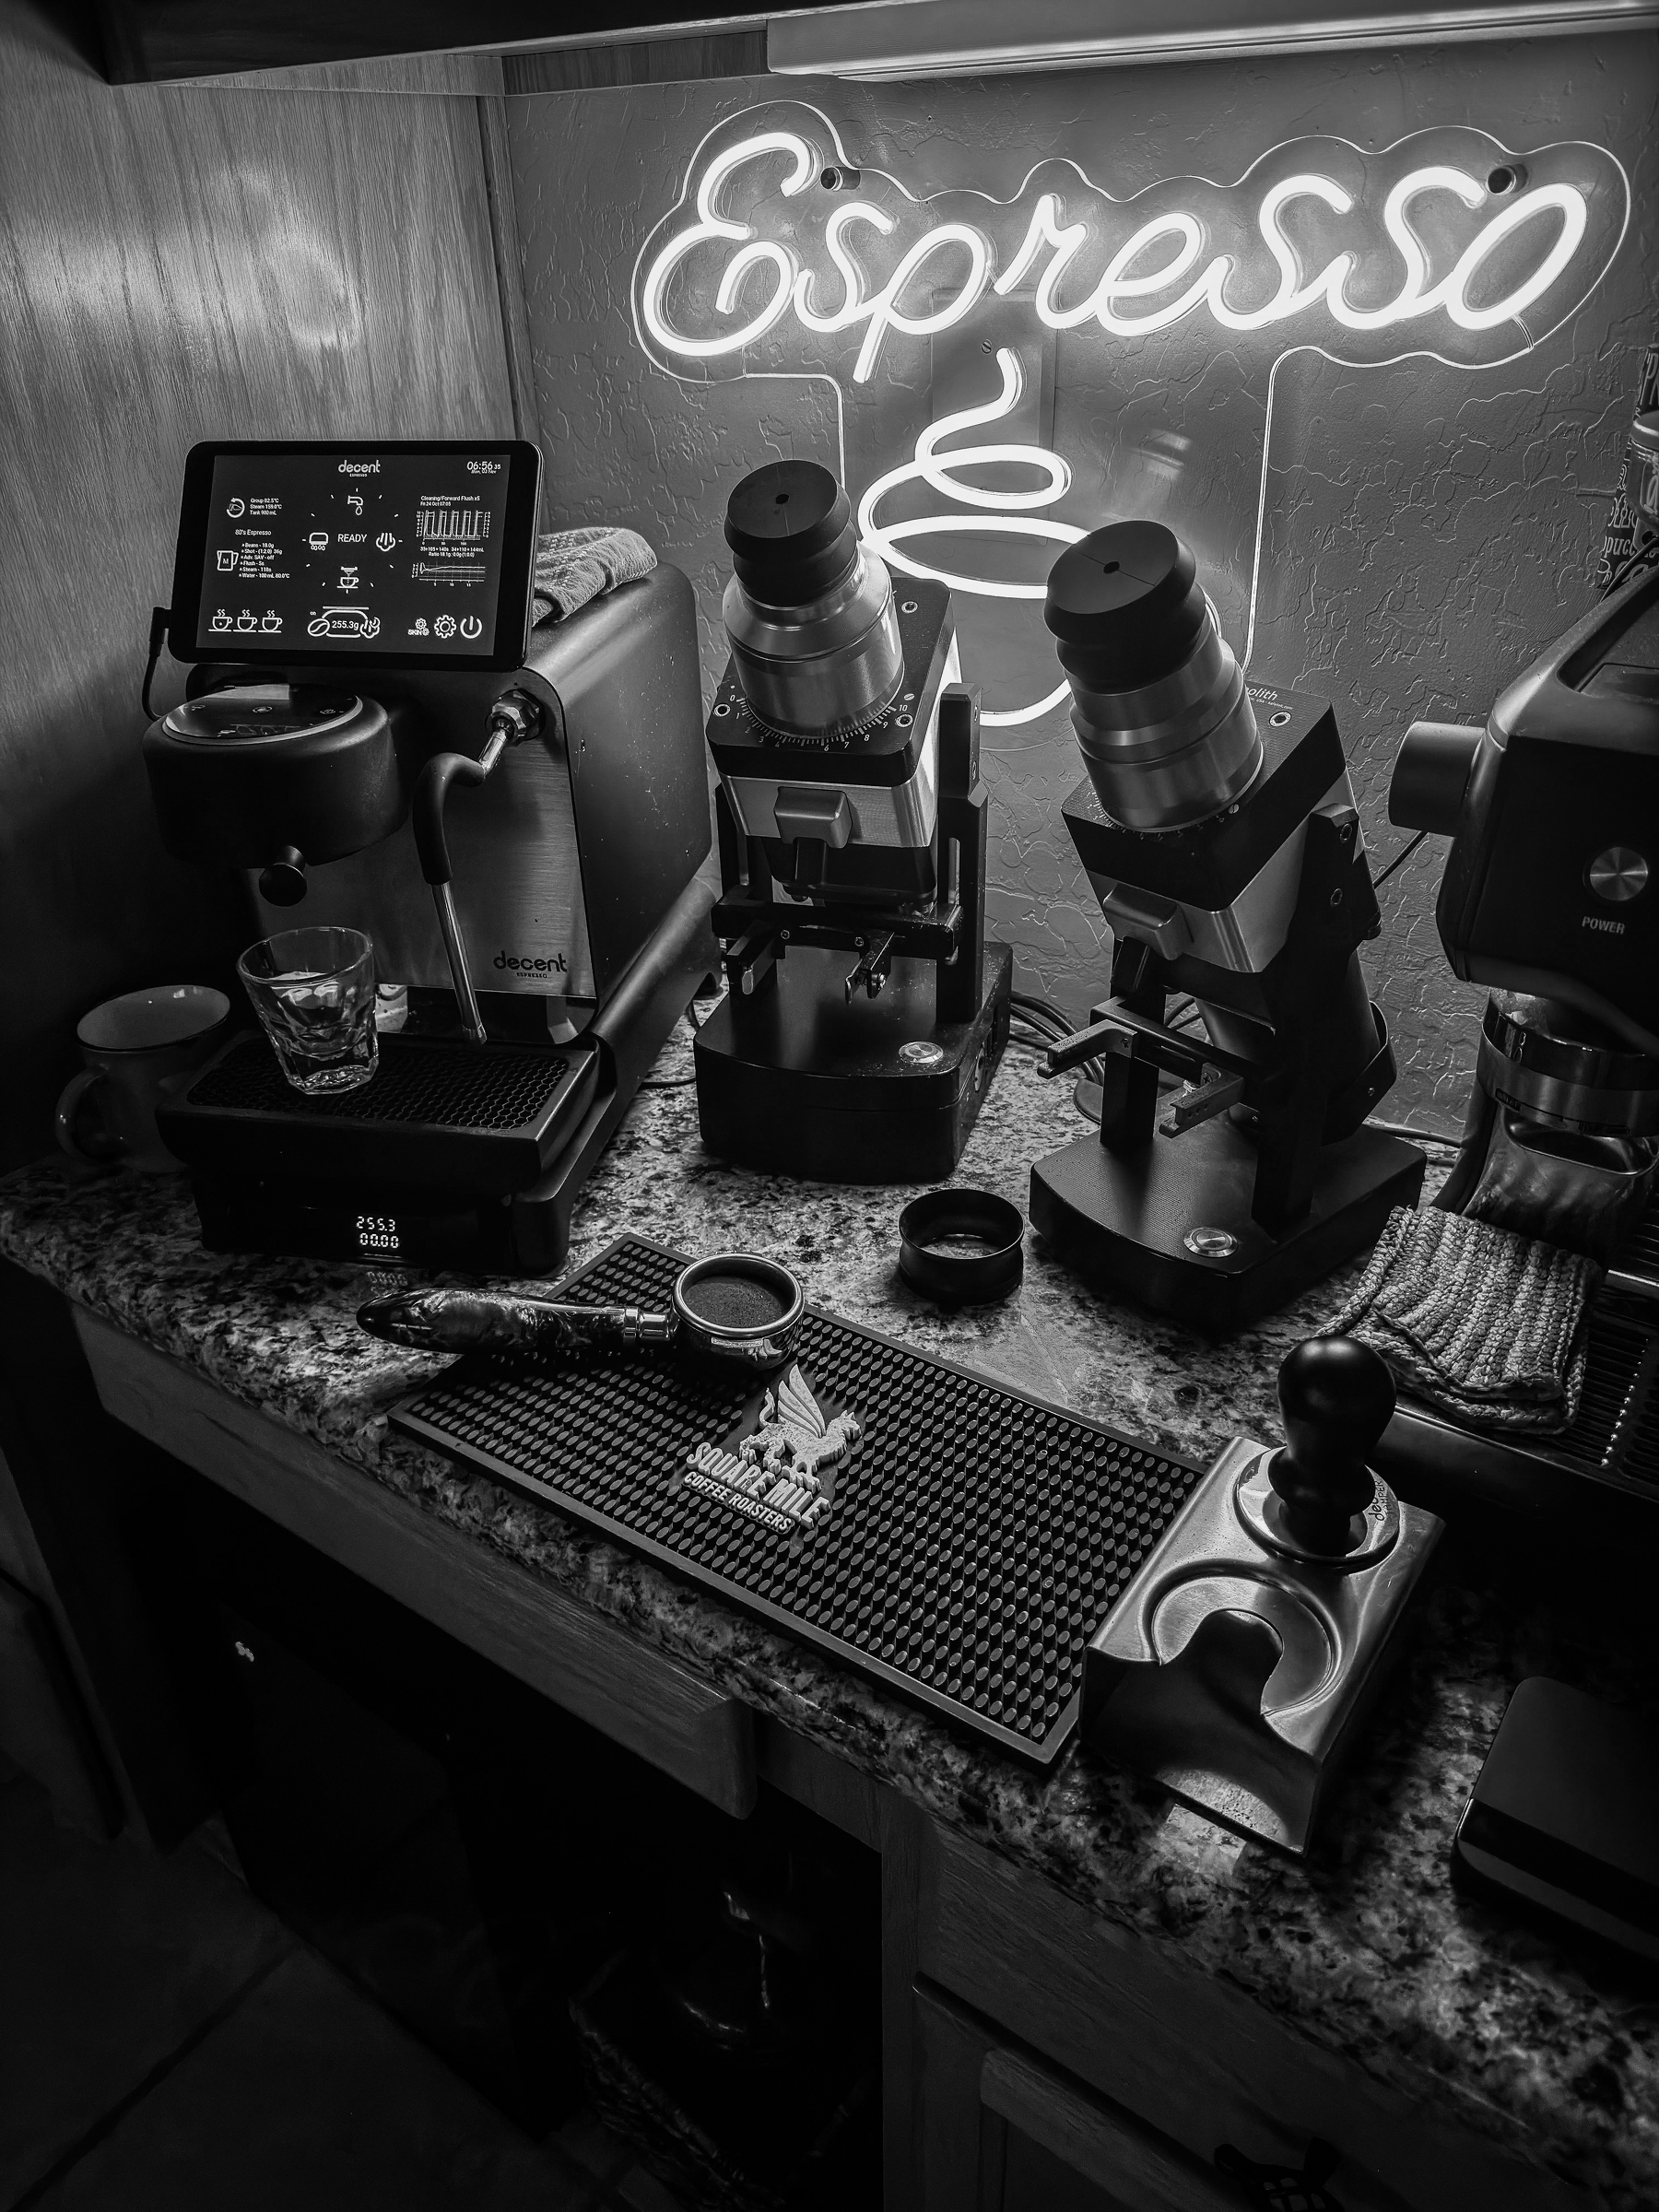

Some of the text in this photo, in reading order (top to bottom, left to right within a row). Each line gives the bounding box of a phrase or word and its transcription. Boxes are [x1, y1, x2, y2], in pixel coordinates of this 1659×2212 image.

[642, 132, 1587, 383] Espresso
[337, 459, 381, 473] decent
[466, 461, 493, 470] 06:56
[337, 534, 367, 542] READY
[332, 620, 359, 631] 255.3g
[1246, 688, 1277, 700] olith
[1582, 916, 1626, 935] POWER
[493, 950, 568, 972] decent
[356, 1217, 395, 1231] 255.3
[359, 1233, 399, 1249] 00.00
[686, 1441, 830, 1530] SQUARE MILE
[684, 1471, 793, 1532] COFFEE ROASTERS
[1374, 1481, 1394, 1514] TAMPER
